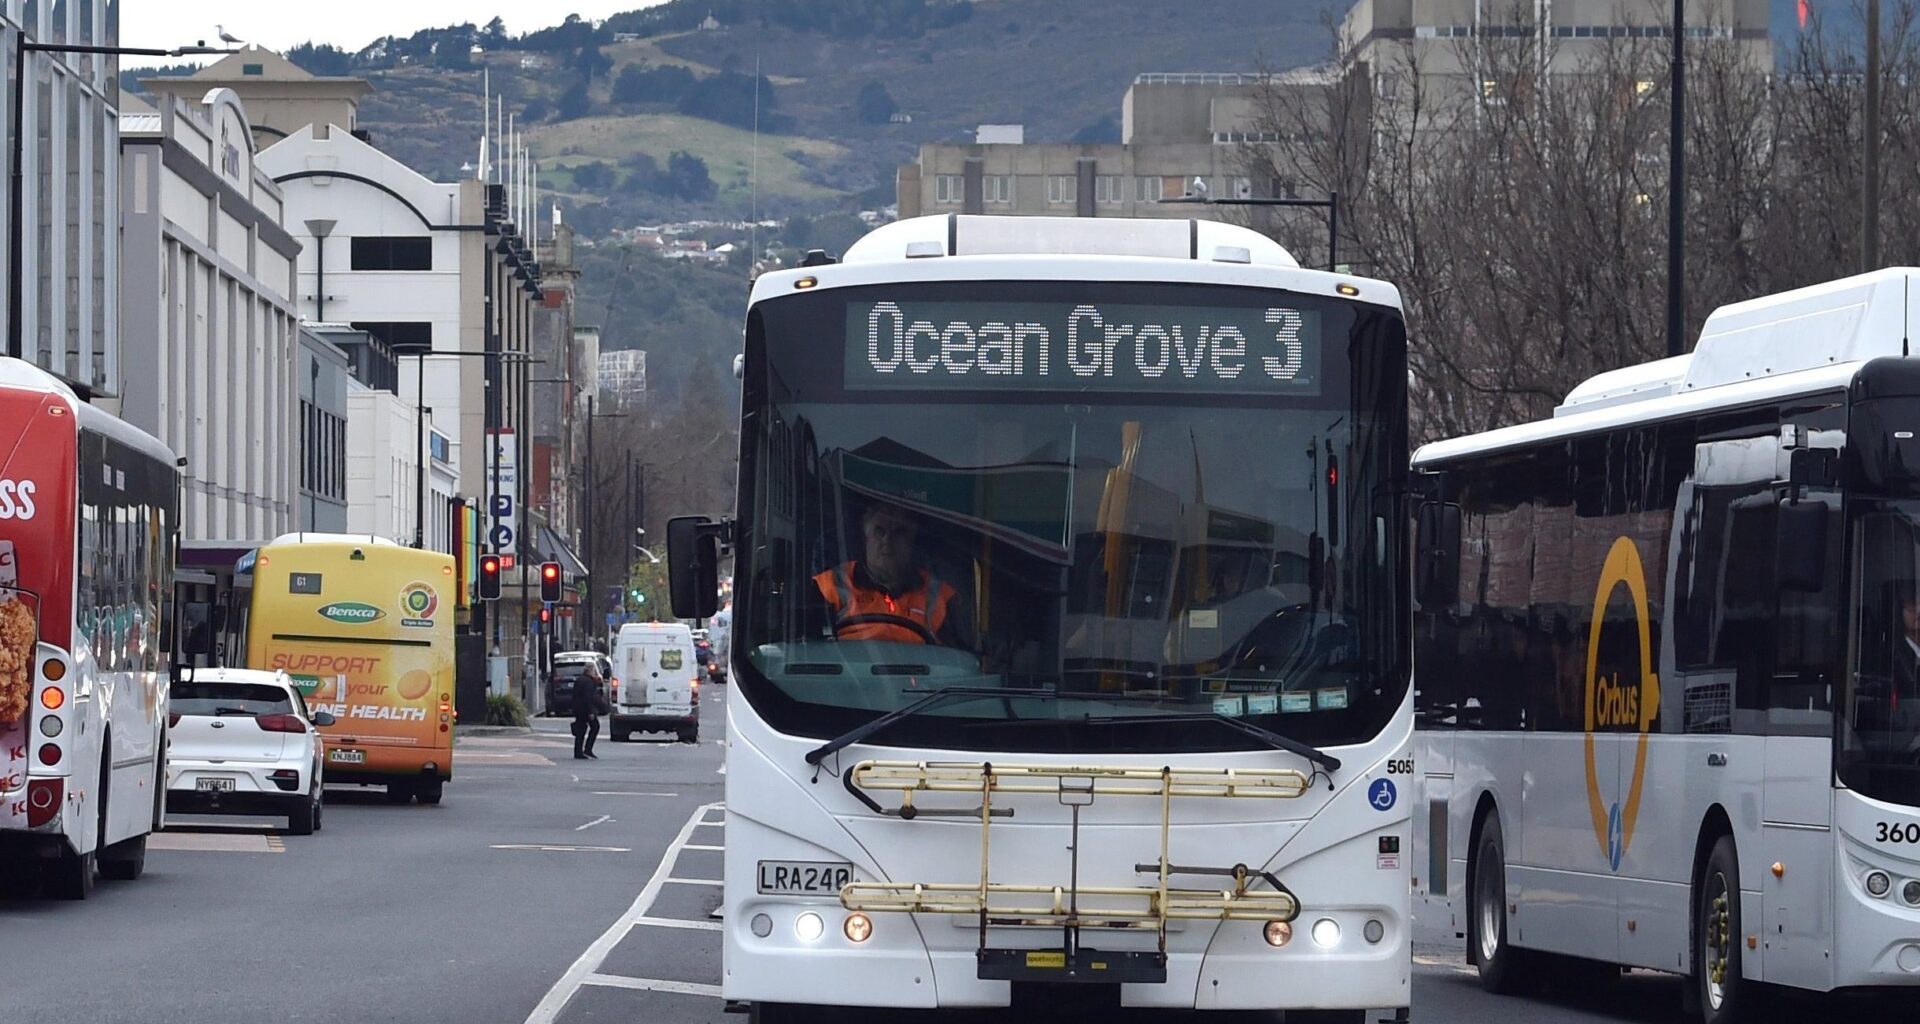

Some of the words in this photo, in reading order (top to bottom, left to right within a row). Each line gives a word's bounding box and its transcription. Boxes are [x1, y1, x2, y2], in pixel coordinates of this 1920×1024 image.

[868, 301, 1049, 375] Ocean
[1068, 304, 1246, 379] Grove
[1261, 307, 1302, 380] 3
[488, 474, 513, 482] PKING
[500, 556, 513, 567] EN
[326, 605, 376, 618] Berocca
[271, 653, 381, 674] SUPPORT
[345, 683, 389, 698] your
[1597, 671, 1638, 727] Orbus
[307, 702, 347, 719] UNE
[350, 704, 426, 721] HEALTH
[761, 866, 850, 892] LRA240
